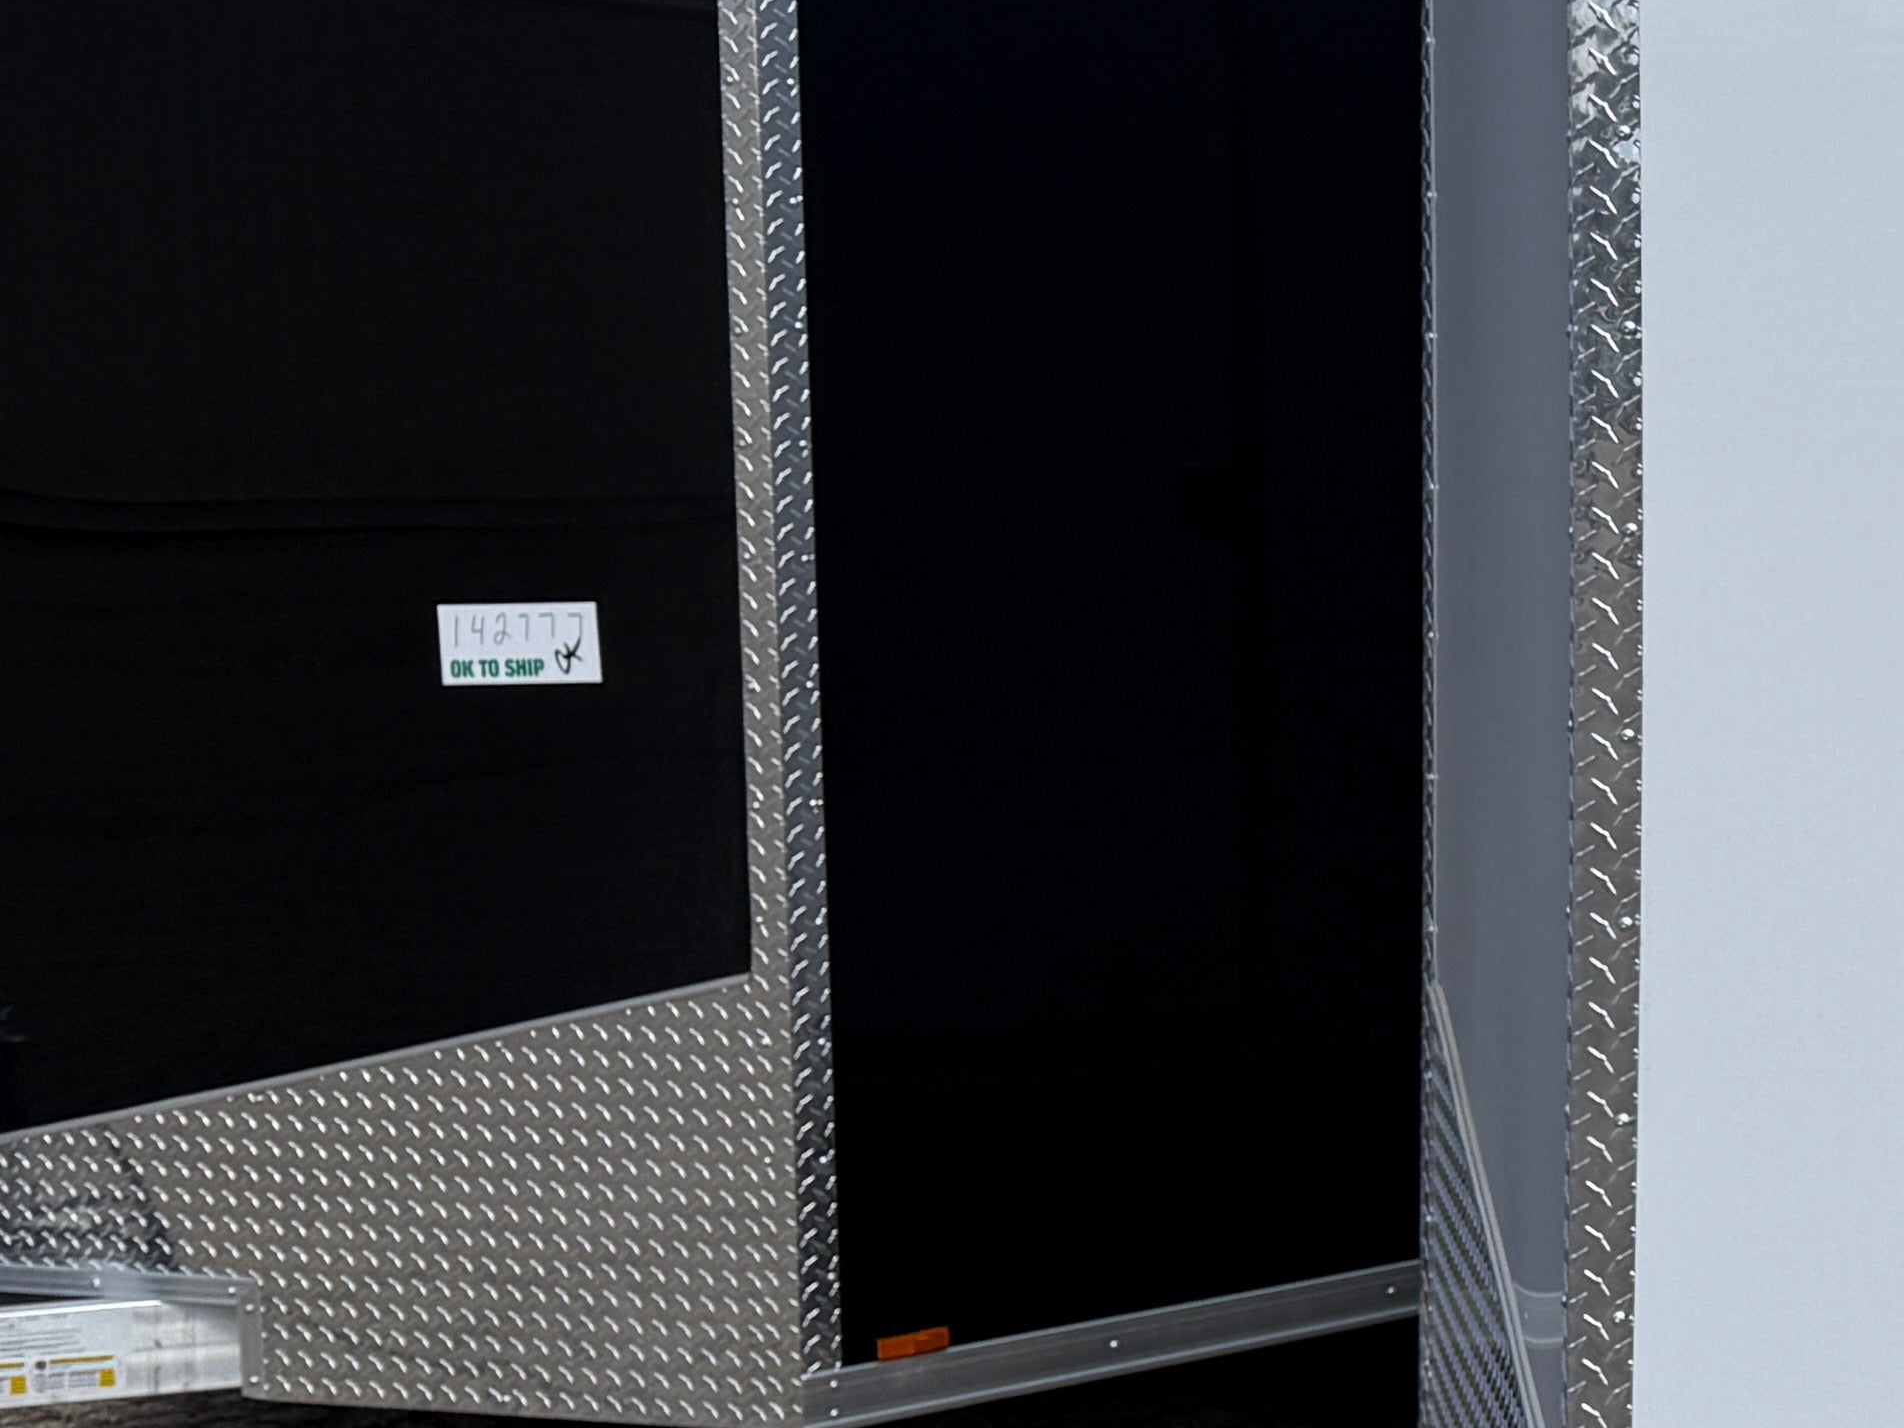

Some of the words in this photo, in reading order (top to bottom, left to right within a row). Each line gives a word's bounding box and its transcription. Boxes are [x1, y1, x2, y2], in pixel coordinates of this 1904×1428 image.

[450, 659, 475, 678] OK
[478, 659, 499, 678] TO
[504, 657, 545, 677] SHIP
